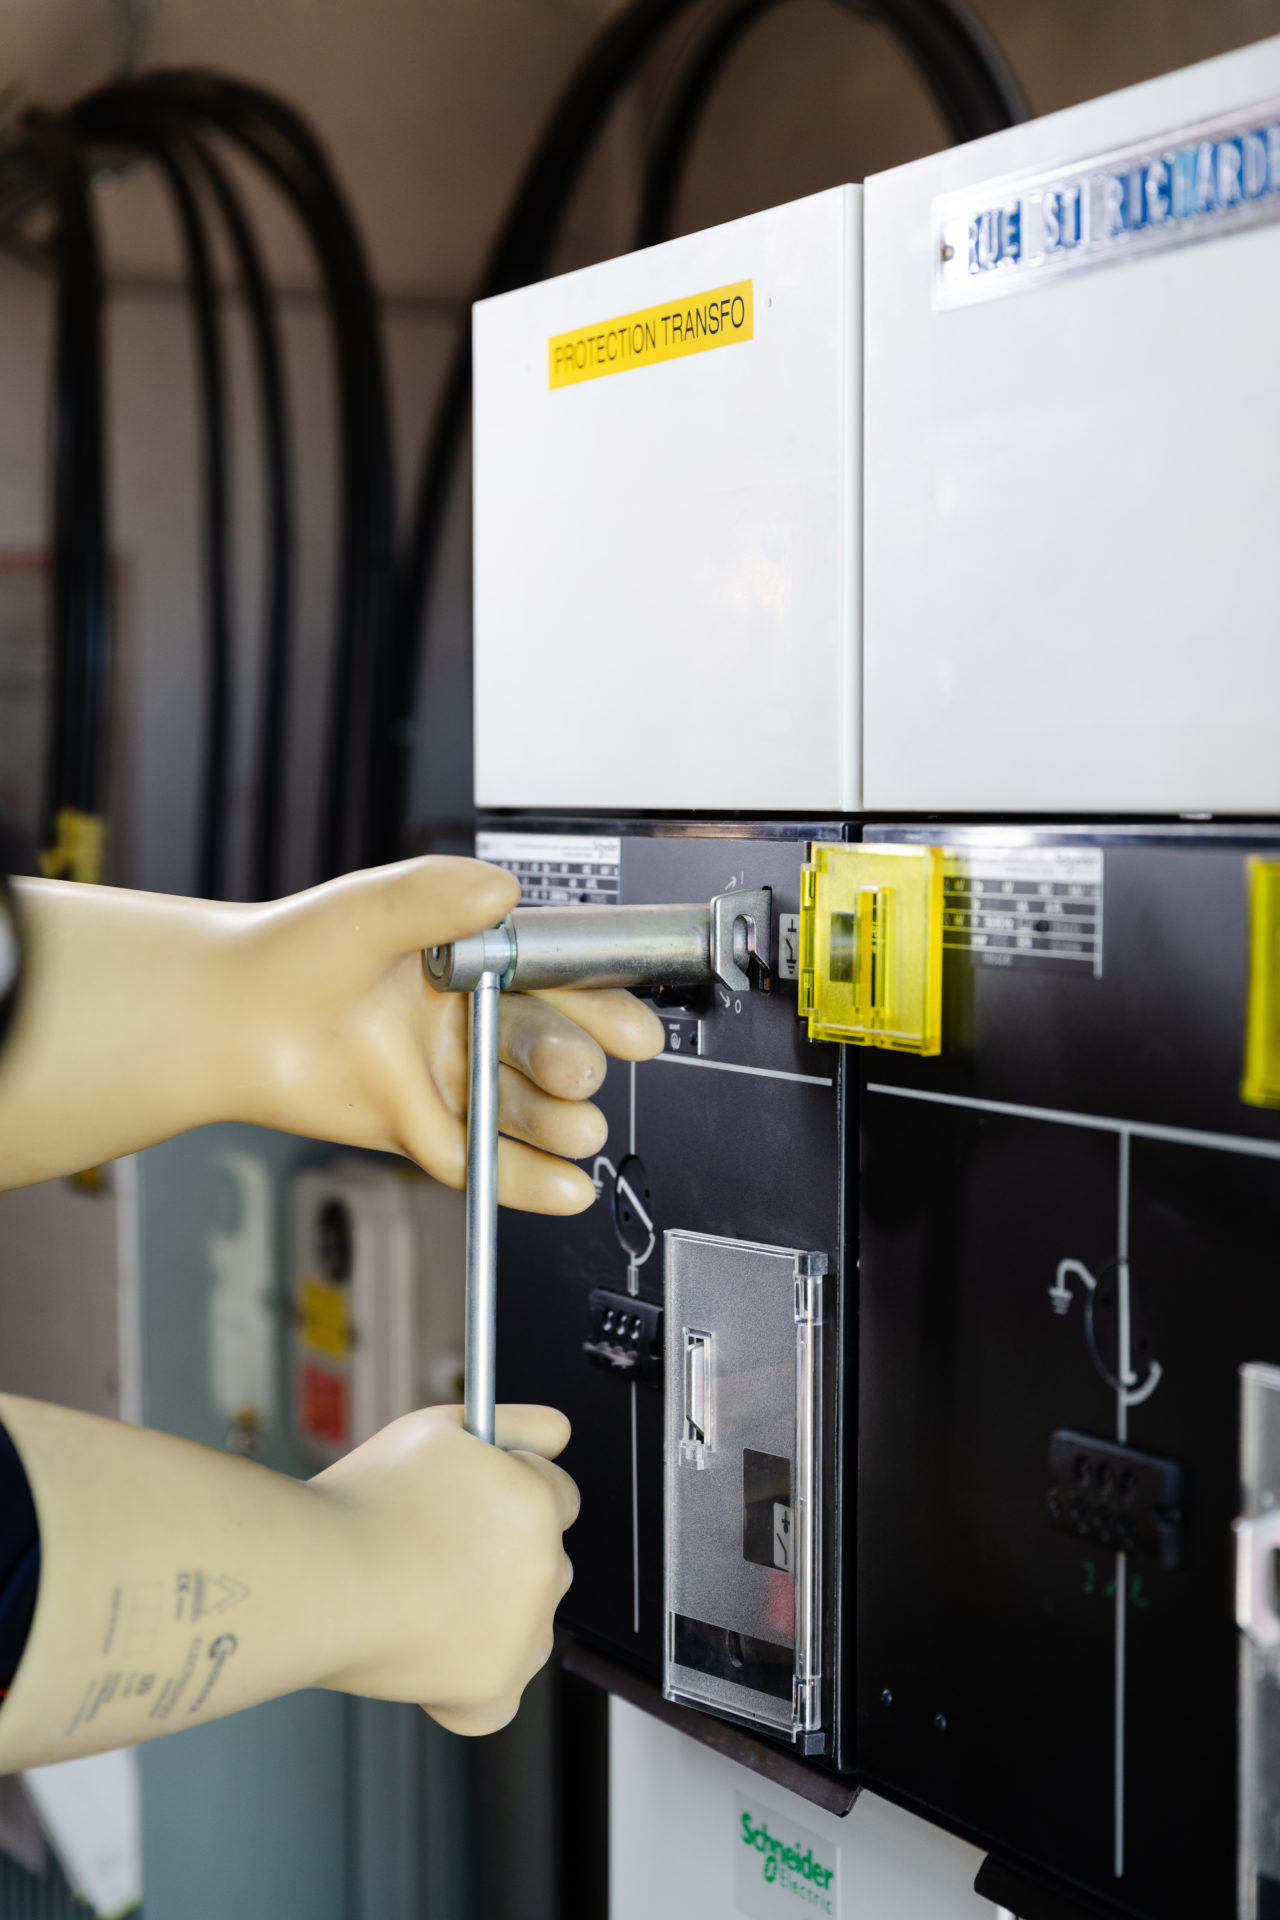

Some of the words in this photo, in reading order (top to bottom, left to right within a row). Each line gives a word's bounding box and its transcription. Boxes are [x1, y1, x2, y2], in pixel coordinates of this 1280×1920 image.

[554, 319, 656, 375] PROTECTION
[661, 295, 745, 346] TRANSFO
[740, 1811, 835, 1891] Schneider
